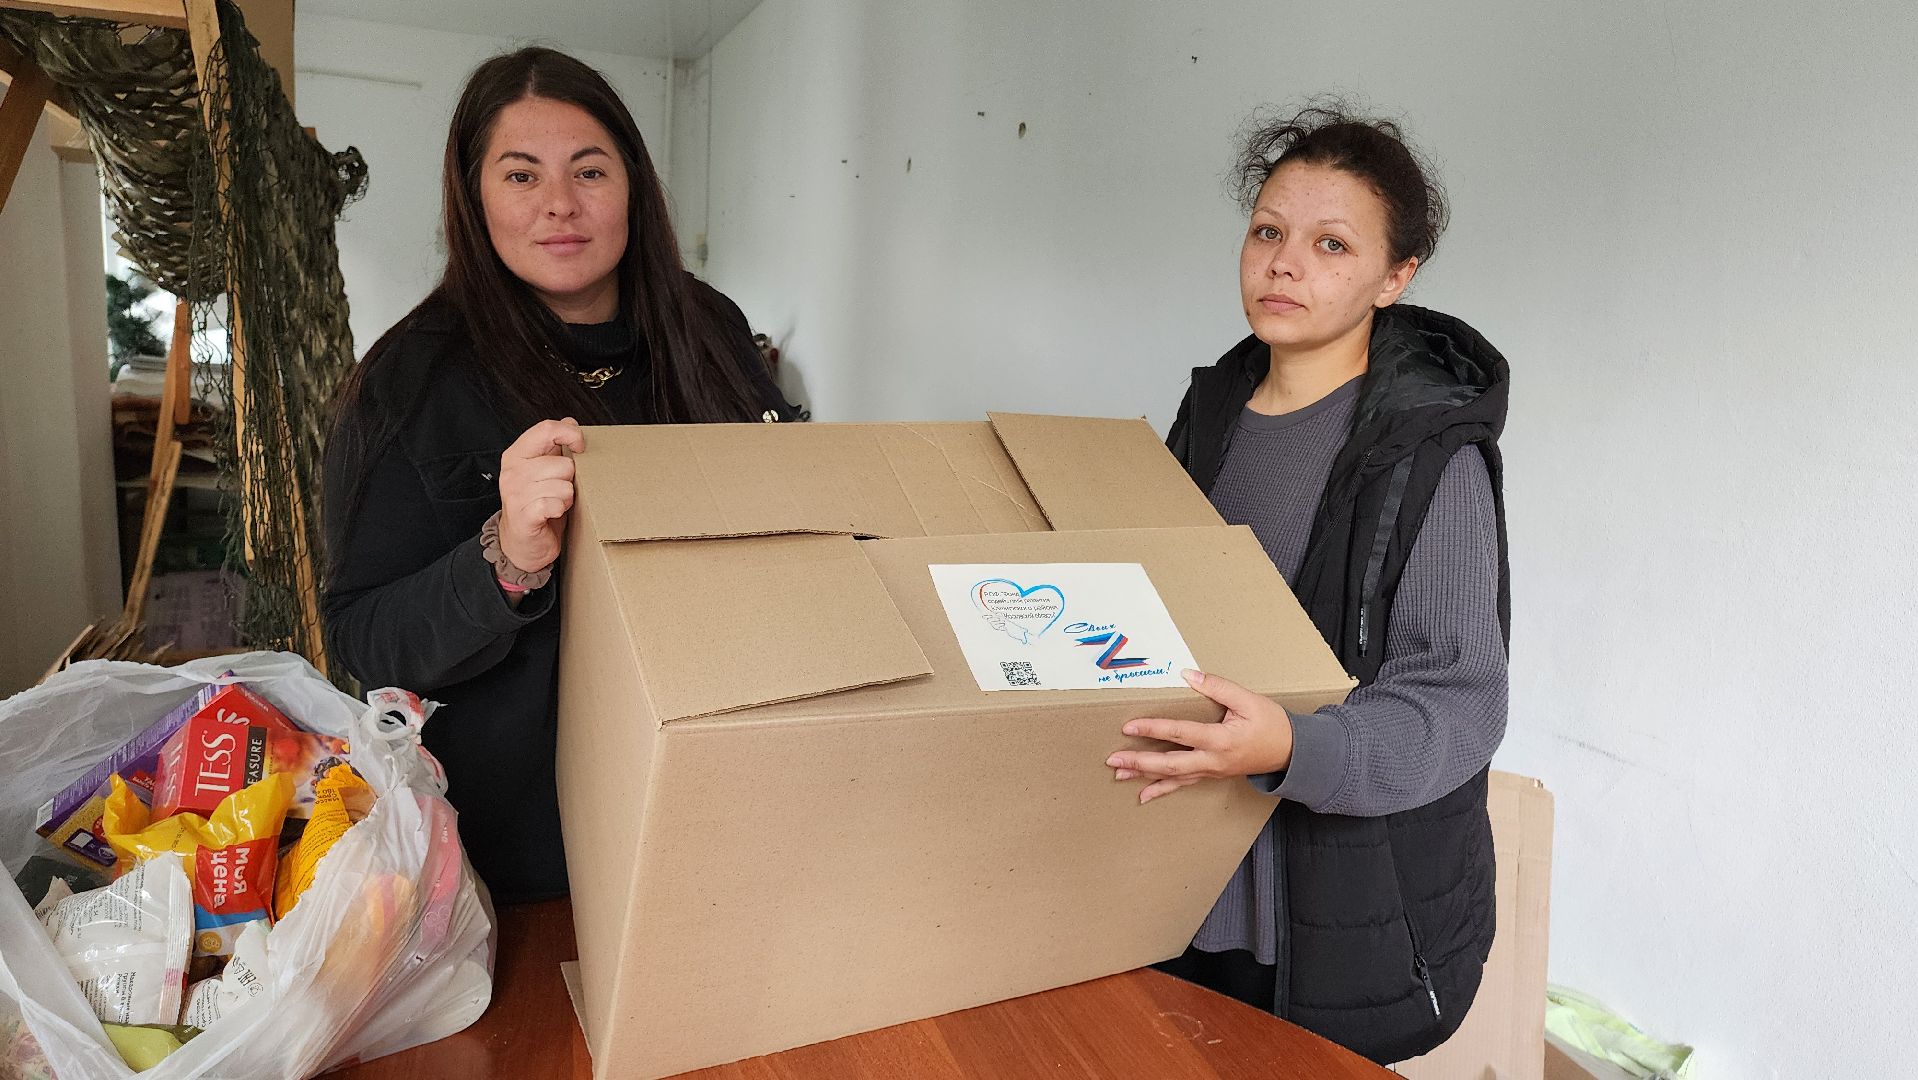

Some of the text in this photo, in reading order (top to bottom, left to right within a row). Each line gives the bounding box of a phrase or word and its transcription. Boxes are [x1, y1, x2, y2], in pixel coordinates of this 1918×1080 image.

[1098, 674, 1112, 683] не
[193, 731, 237, 797] TESS
[247, 738, 263, 786] EASURE
[211, 850, 228, 909] цена
[233, 847, 251, 895] Моя
